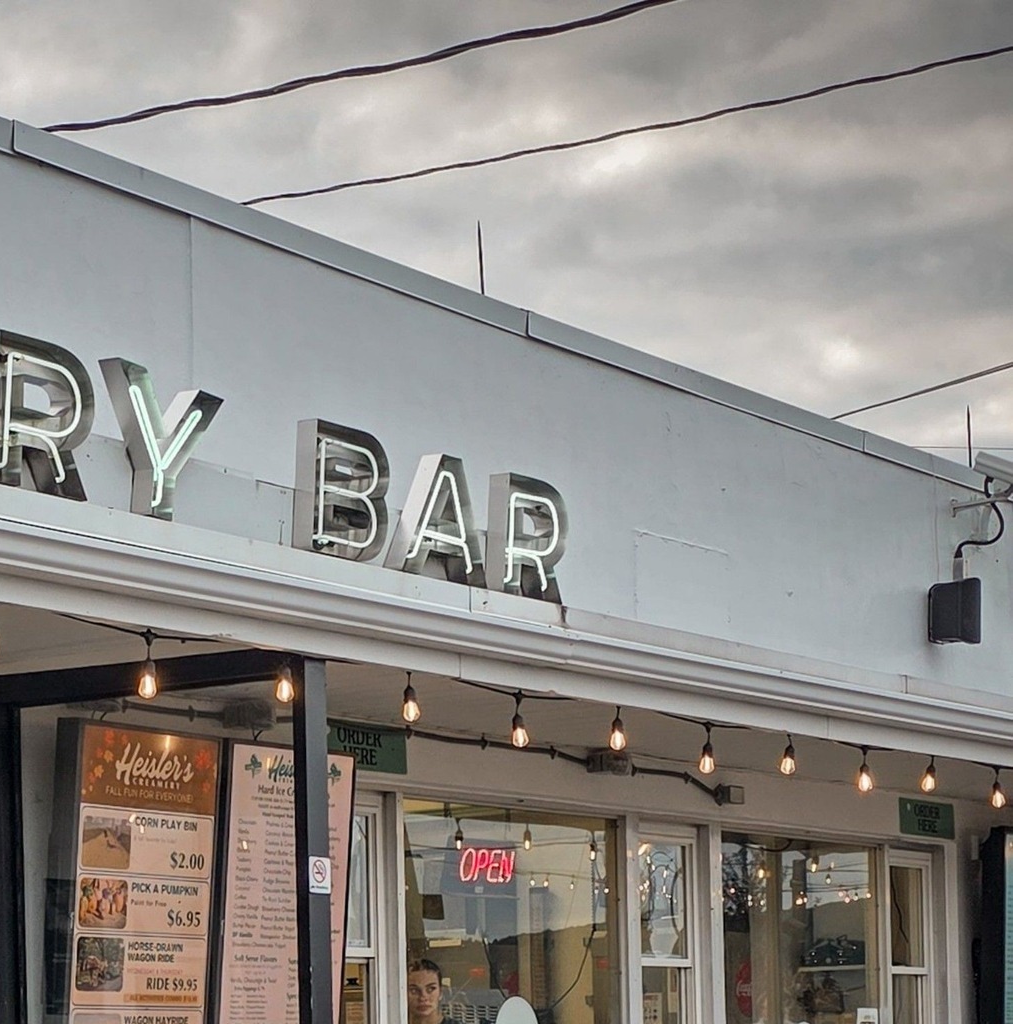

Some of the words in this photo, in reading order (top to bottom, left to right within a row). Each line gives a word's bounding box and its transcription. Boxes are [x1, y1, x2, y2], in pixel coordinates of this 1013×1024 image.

[292, 418, 569, 604] BAR
[337, 727, 382, 748] ORDER
[115, 742, 194, 785] Heisler's
[132, 777, 181, 790] CREAMERY
[257, 784, 275, 795] Hard
[105, 785, 122, 796] FALL
[123, 787, 138, 798] FUN
[139, 789, 155, 799] FOR
[135, 816, 158, 828] CORN
[160, 819, 182, 830] PLAY
[184, 821, 198, 832] BIN
[917, 818, 938, 833] HERE
[170, 851, 205, 870] $2.00
[459, 847, 516, 883] OPEN
[131, 882, 152, 894] PICK
[153, 884, 159, 894] A
[161, 884, 199, 896] PUMPKIN
[167, 908, 201, 928] $6.95
[128, 941, 183, 952] HORSE-DRAWN
[127, 953, 156, 963] WAGON
[157, 954, 175, 963] RIDE
[146, 977, 169, 990] RIDE
[172, 977, 198, 992] $9.95
[124, 1016, 154, 1024] WAGON
